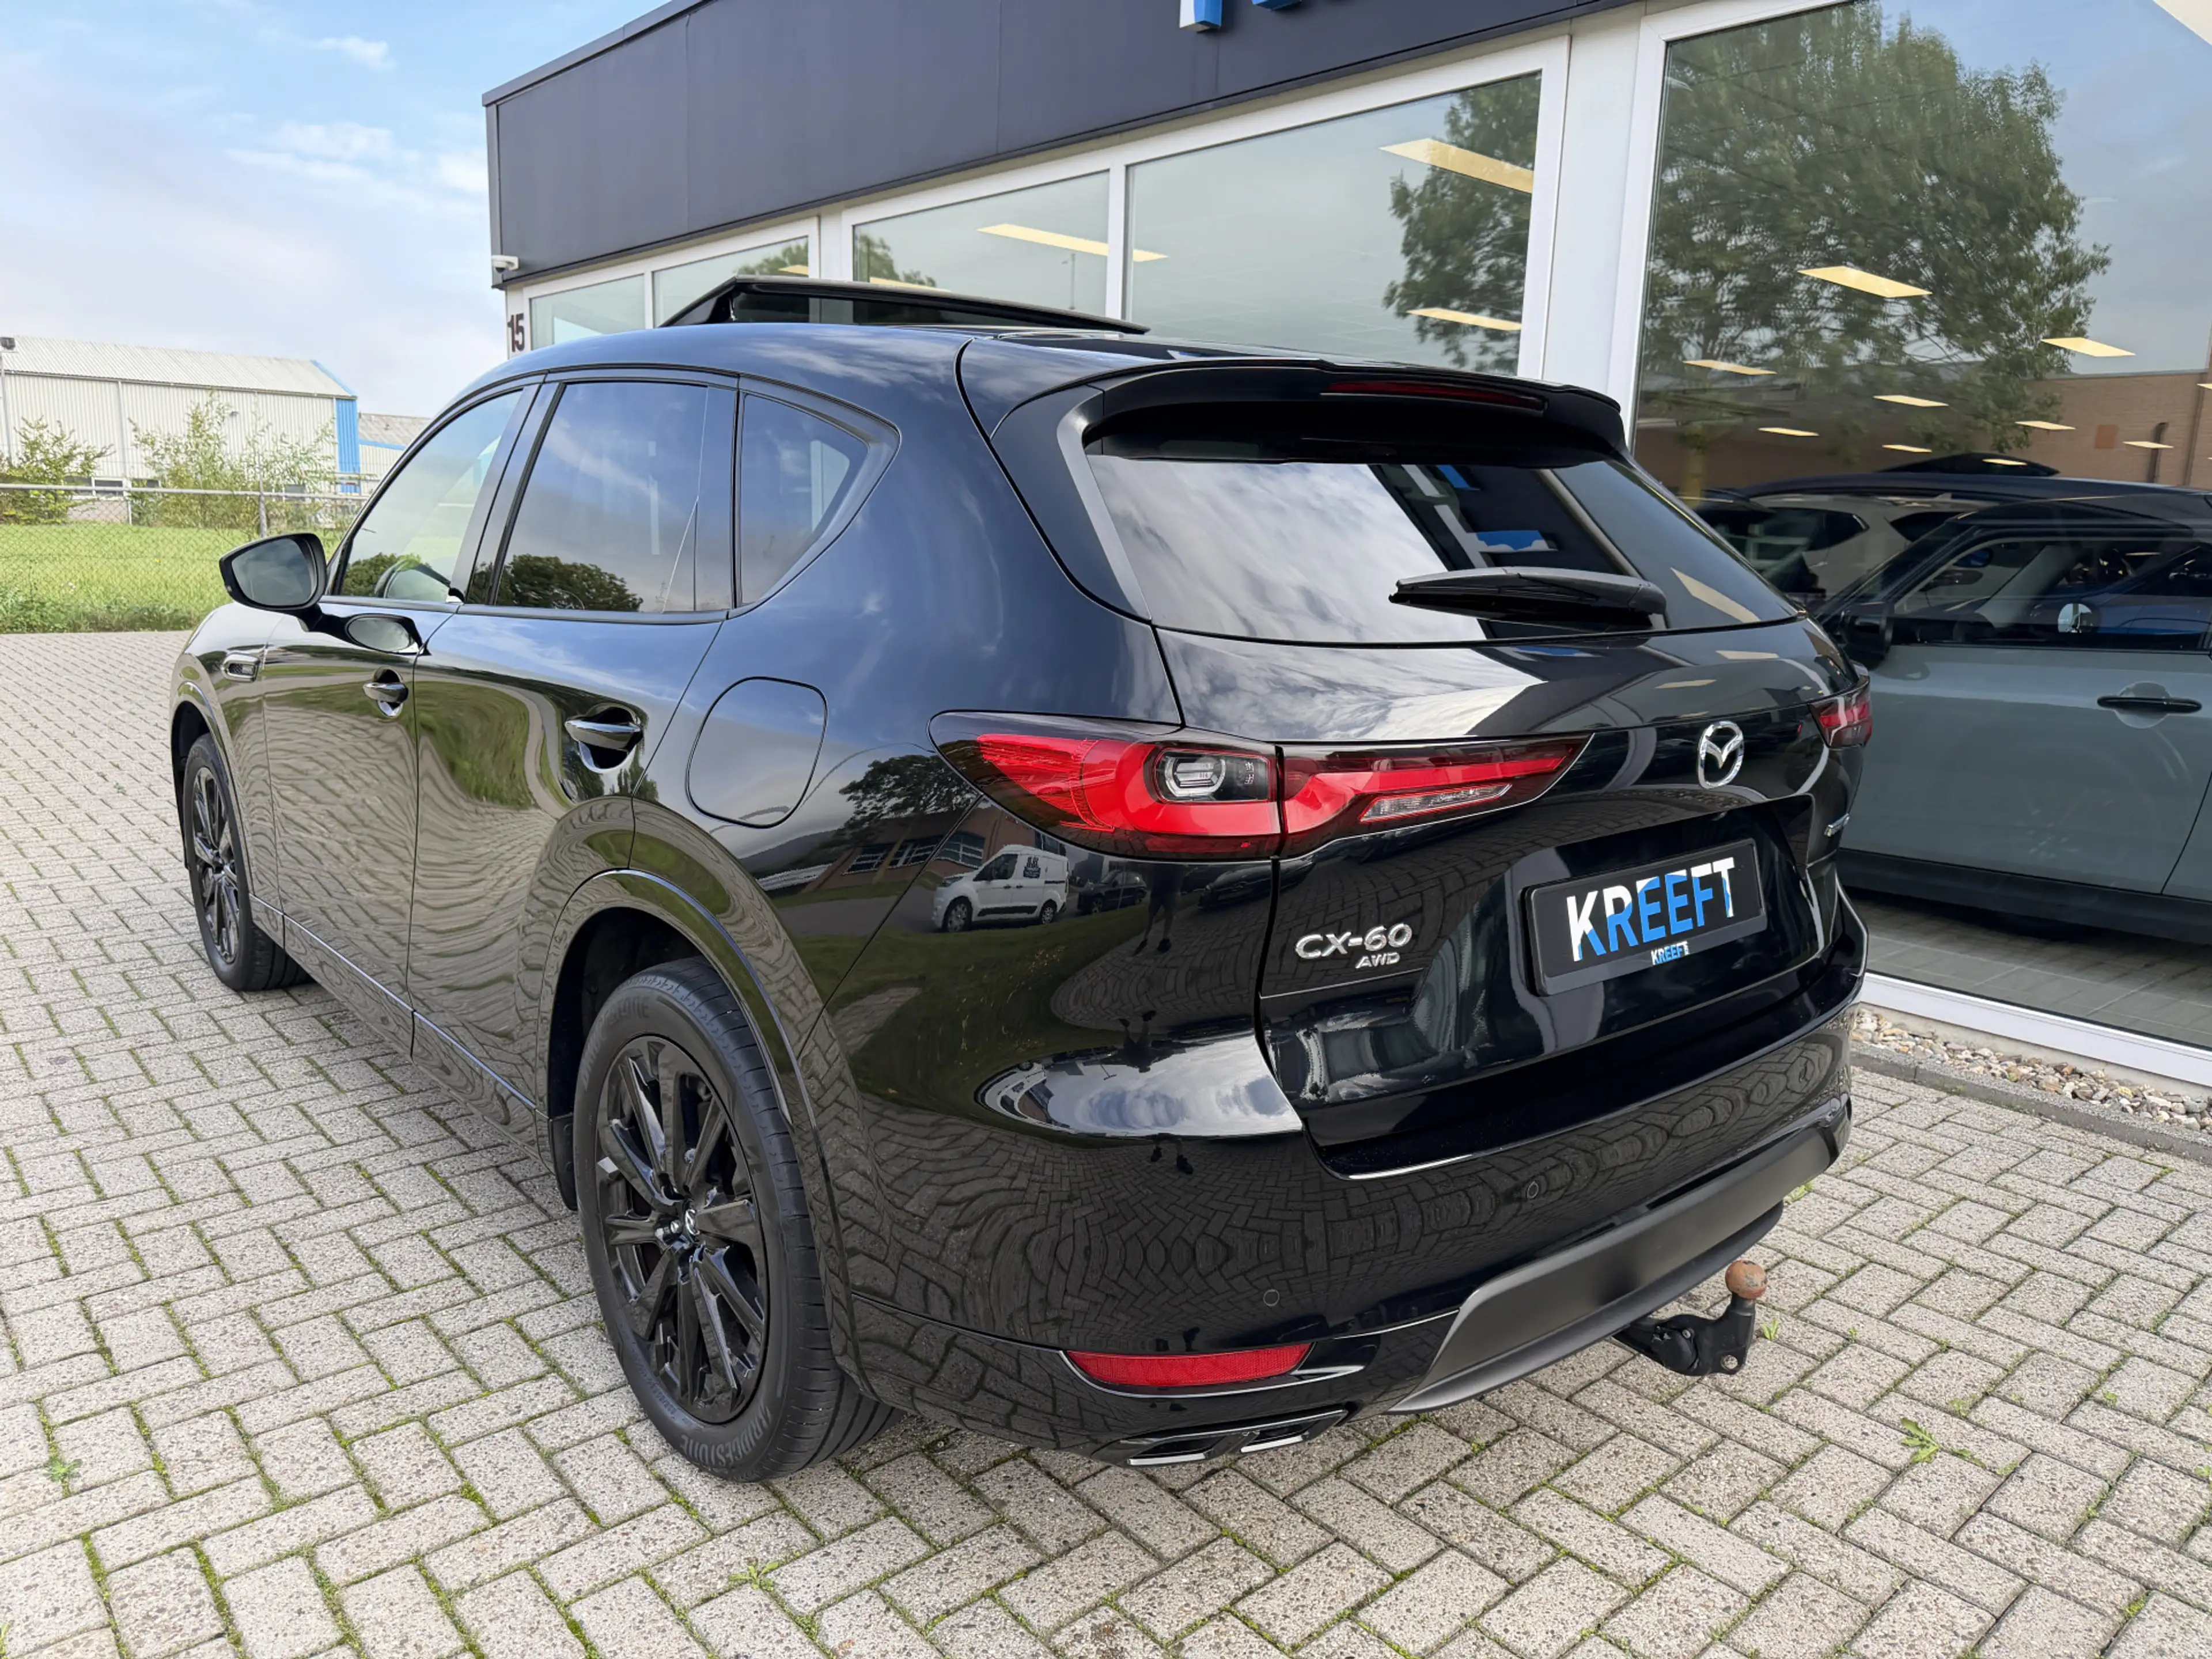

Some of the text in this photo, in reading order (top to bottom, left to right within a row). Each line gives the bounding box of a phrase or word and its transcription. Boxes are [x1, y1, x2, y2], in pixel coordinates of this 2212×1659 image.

[507, 313, 525, 353] 15
[1566, 857, 1735, 962] KREEFT
[1295, 923, 1412, 959] CX-60
[1651, 940, 1690, 965] KREEFT
[1355, 952, 1400, 969] AWD
